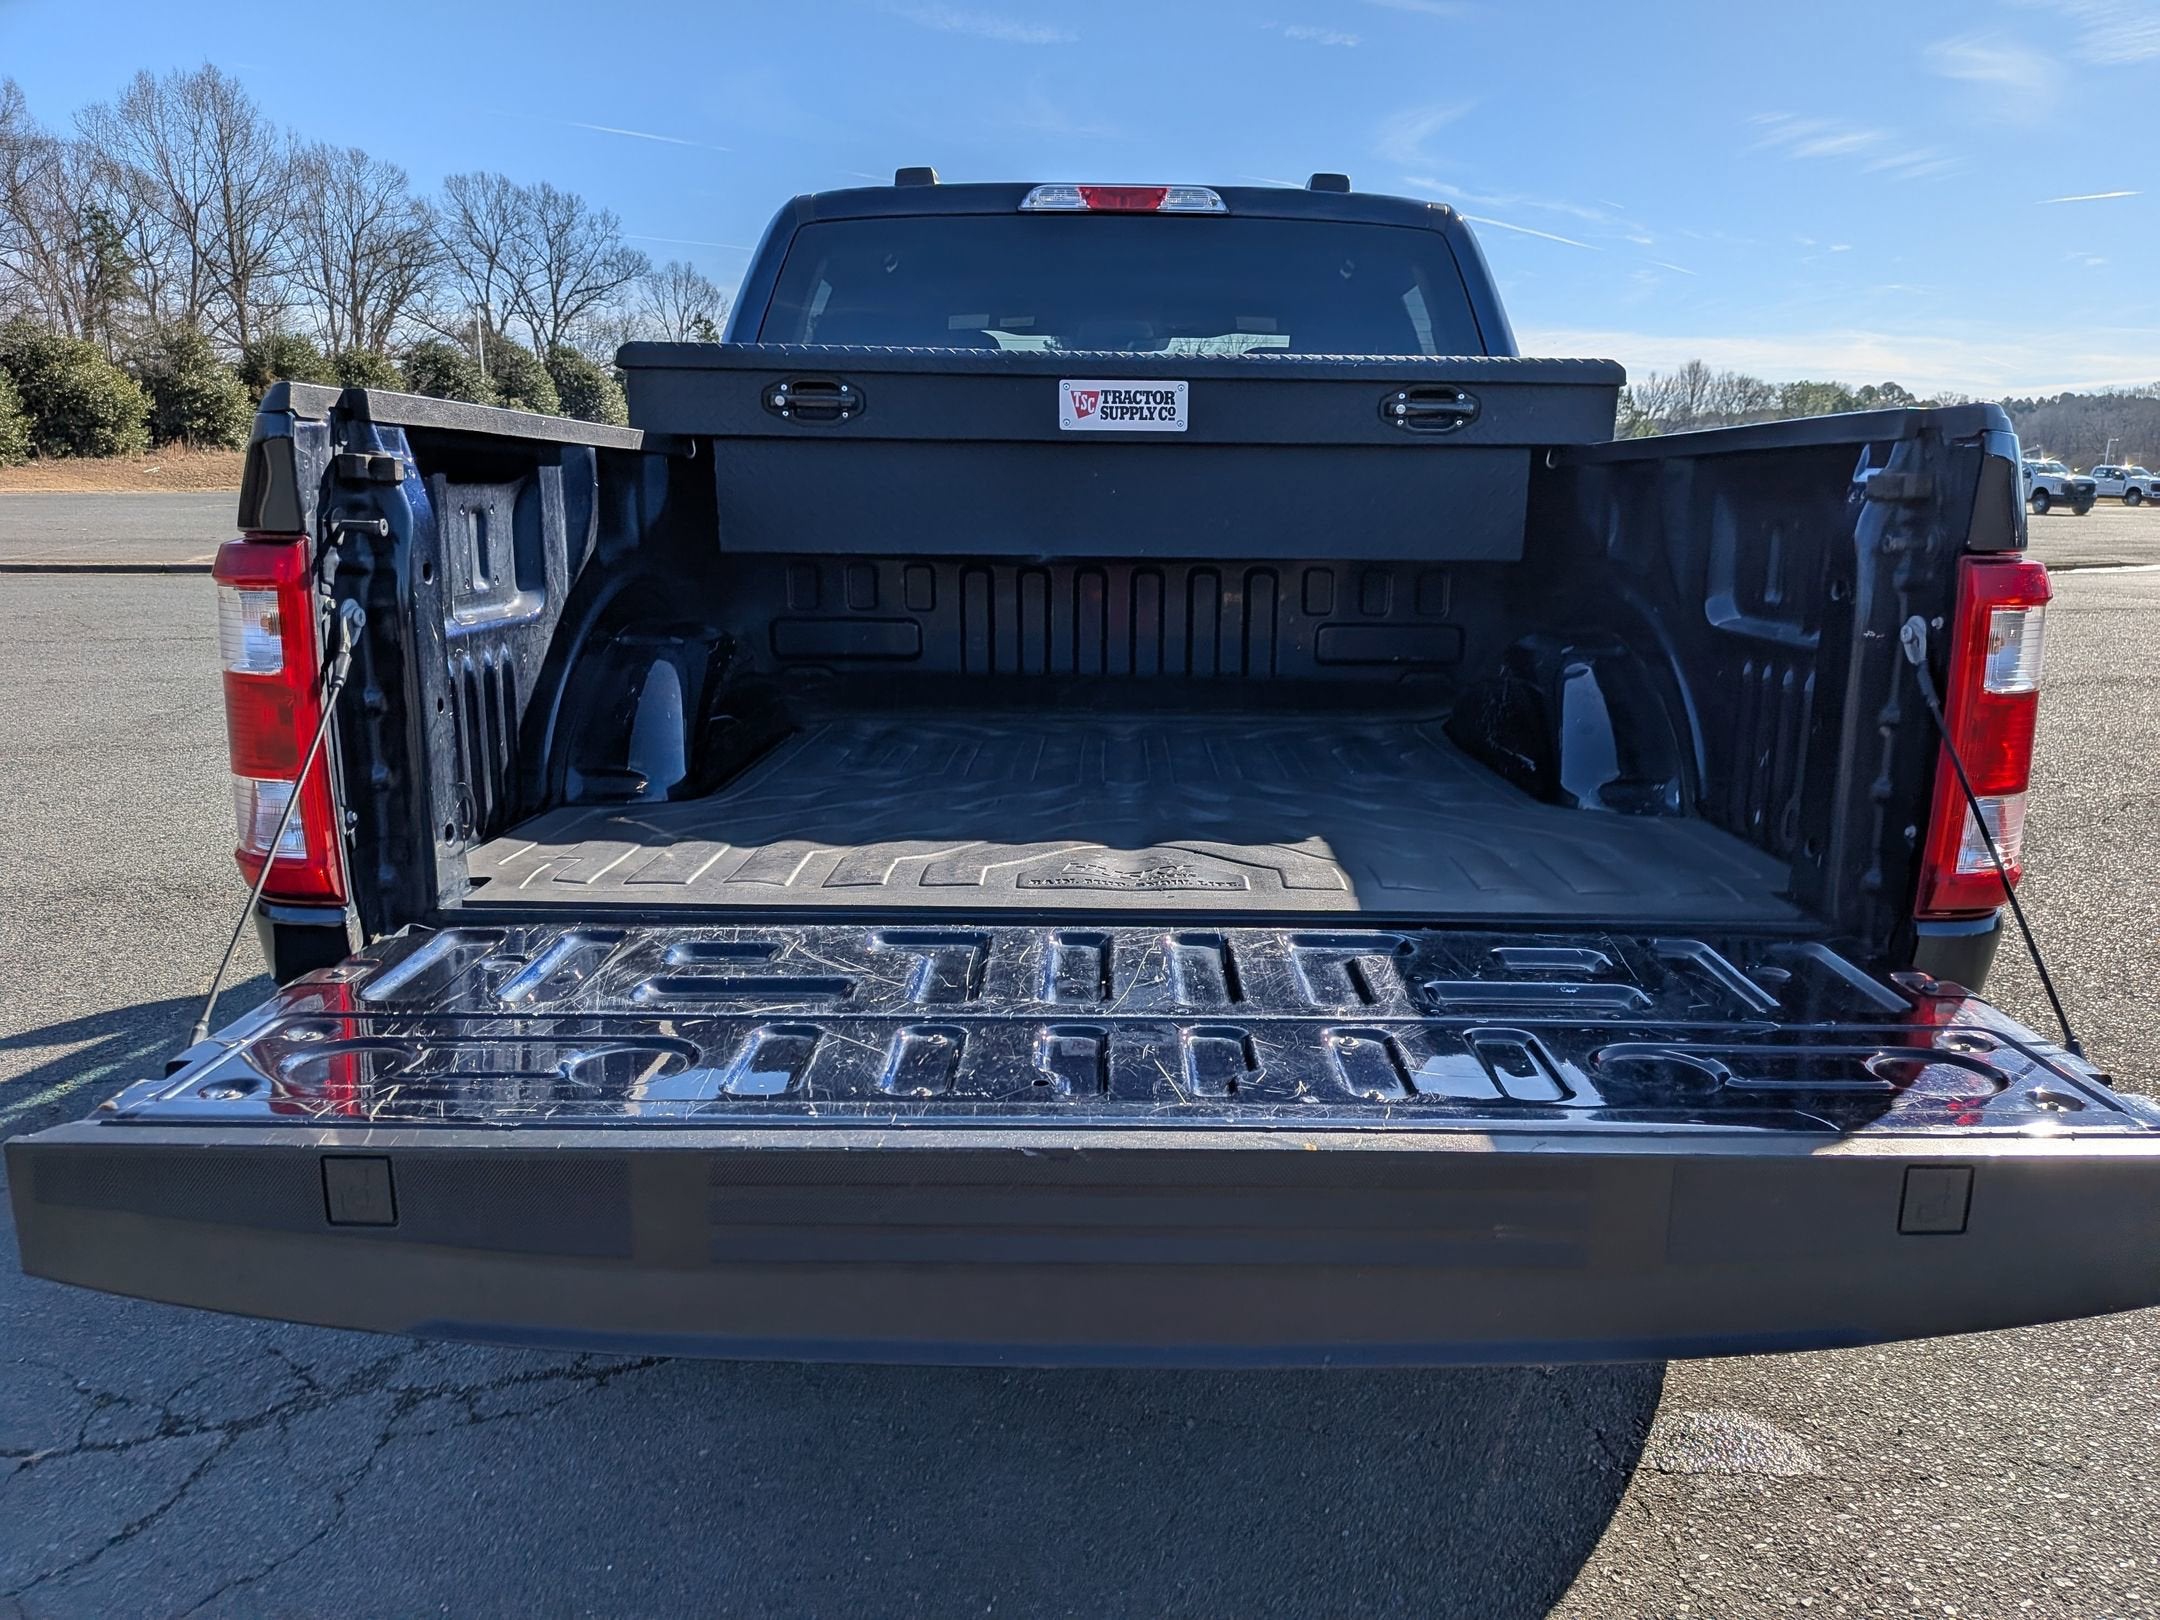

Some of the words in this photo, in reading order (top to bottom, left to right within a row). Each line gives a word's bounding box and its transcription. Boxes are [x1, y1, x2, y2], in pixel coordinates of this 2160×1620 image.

[1073, 391, 1095, 413] TSC
[1100, 390, 1176, 405] TRACTOR
[1100, 406, 1159, 421] SUPPLY
